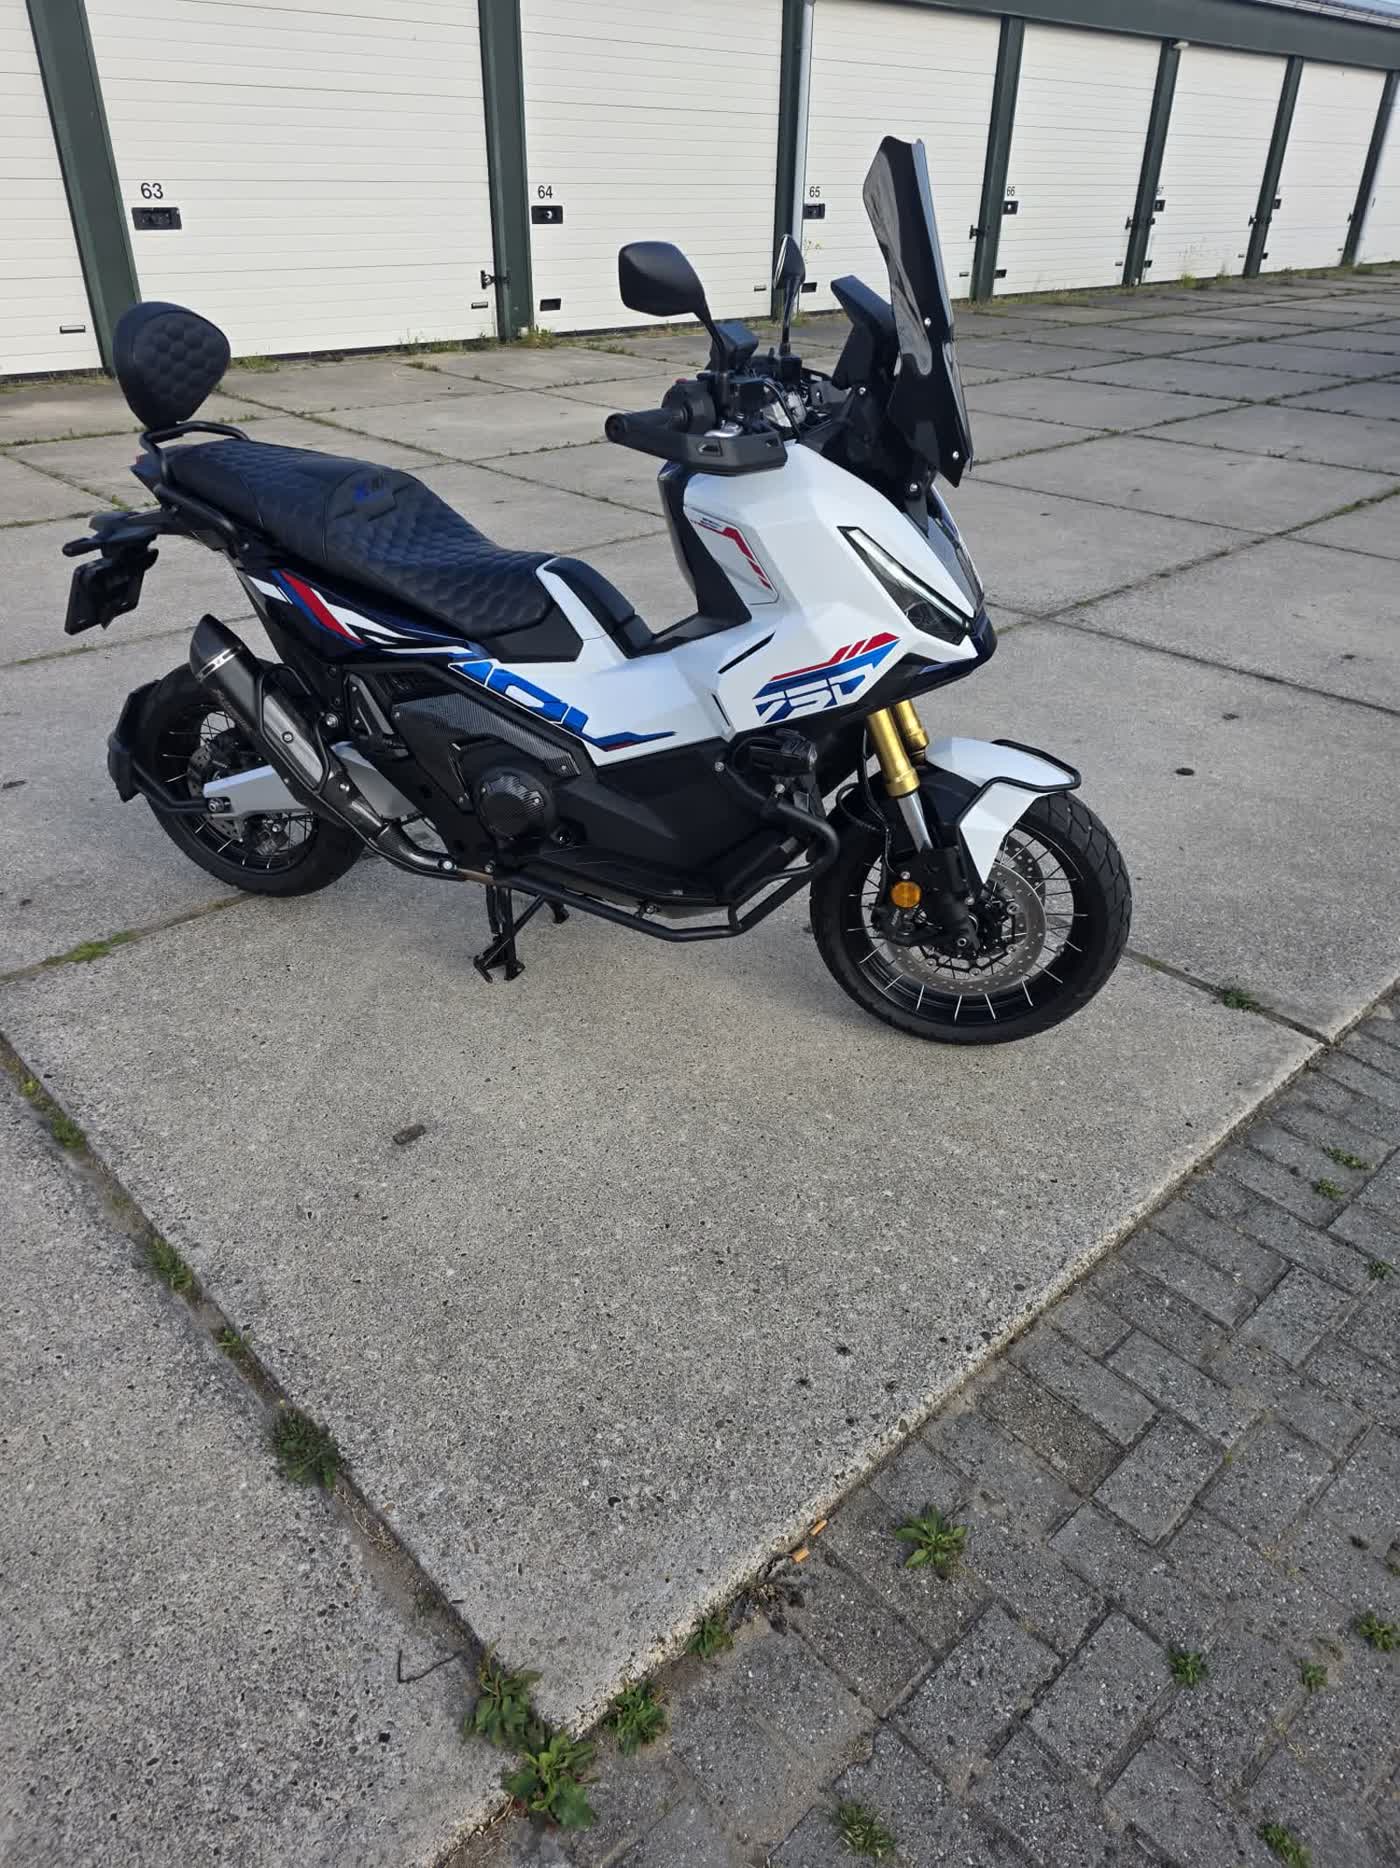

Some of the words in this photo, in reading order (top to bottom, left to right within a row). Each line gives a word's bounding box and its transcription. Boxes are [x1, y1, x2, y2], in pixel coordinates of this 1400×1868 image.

[140, 182, 164, 200] 63
[537, 184, 553, 200] 64
[809, 185, 821, 198] 65
[1006, 185, 1016, 197] 66
